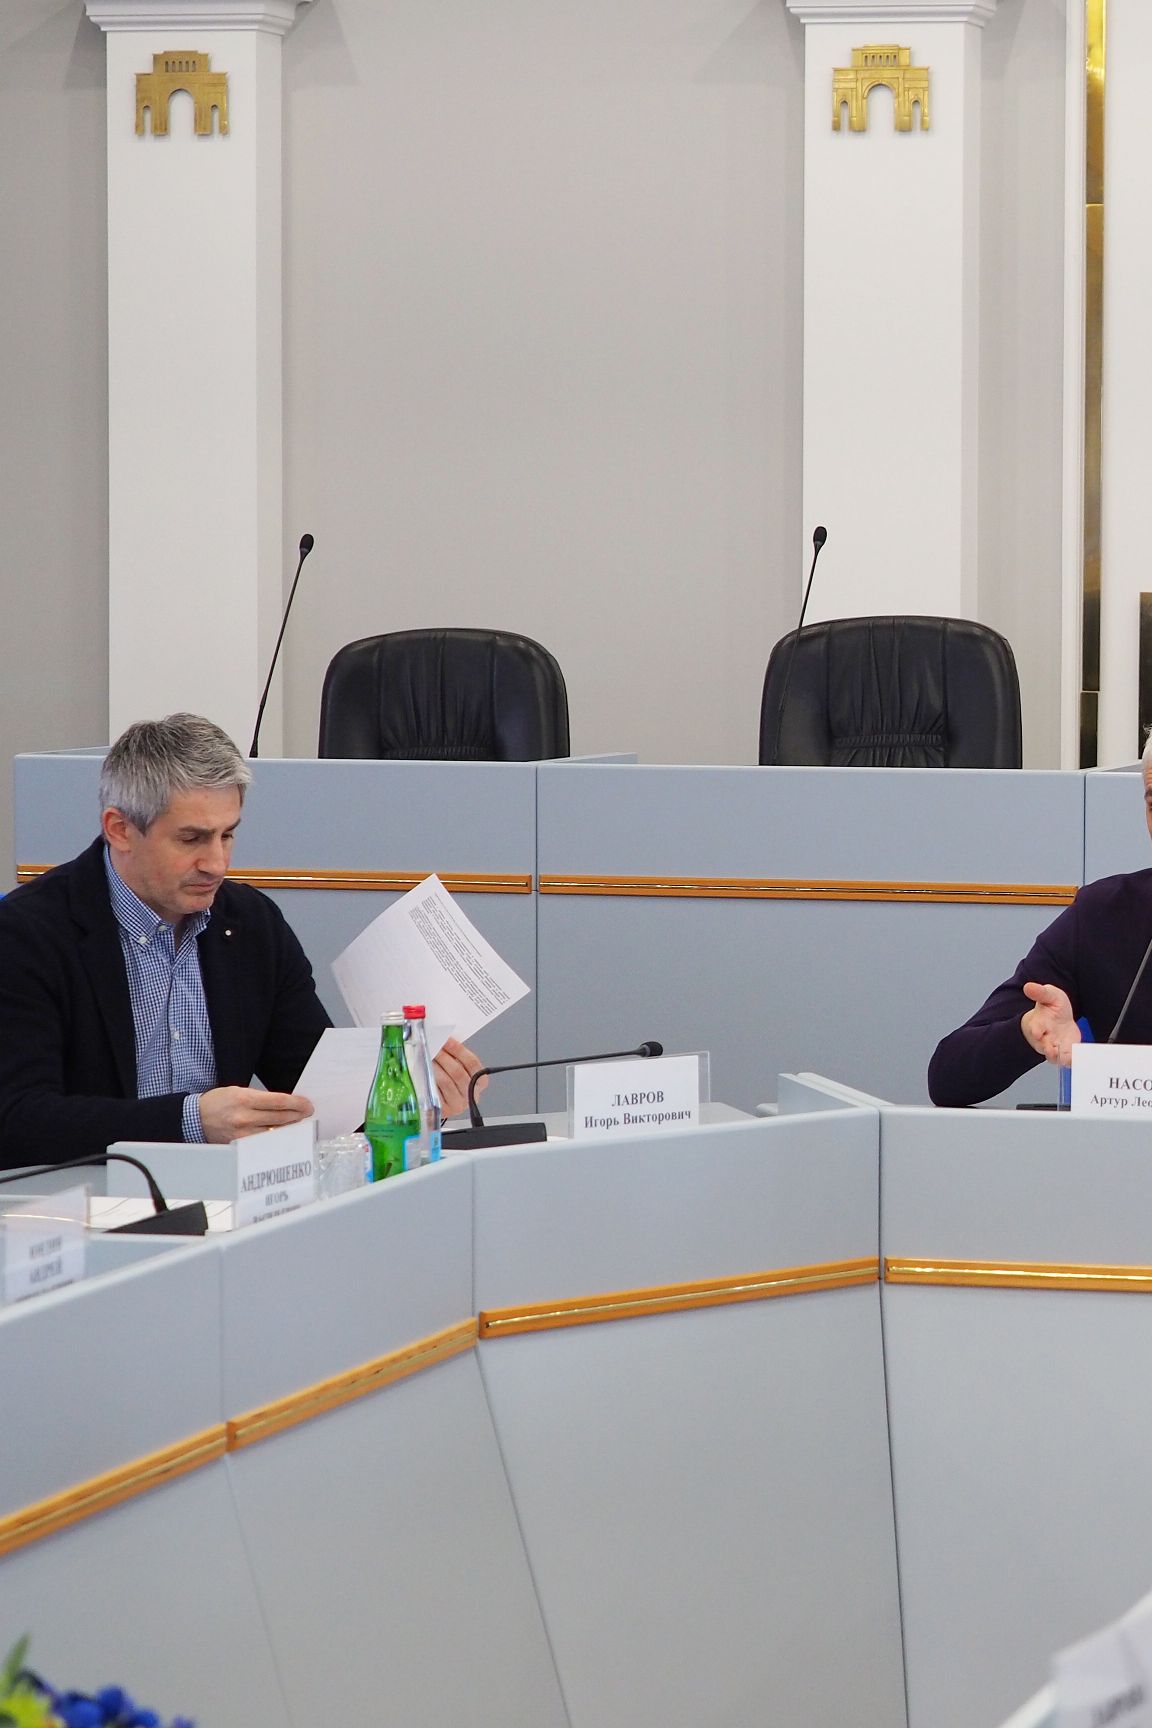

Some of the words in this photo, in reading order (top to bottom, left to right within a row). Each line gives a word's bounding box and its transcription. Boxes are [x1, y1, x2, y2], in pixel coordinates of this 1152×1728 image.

[611, 1090, 665, 1107] ЛАВРОВ
[1090, 1094, 1128, 1109] Артур
[584, 1115, 620, 1130] Игорь
[623, 1110, 692, 1126] Викторович
[240, 1160, 312, 1193] АНДРЮЩЕНКО
